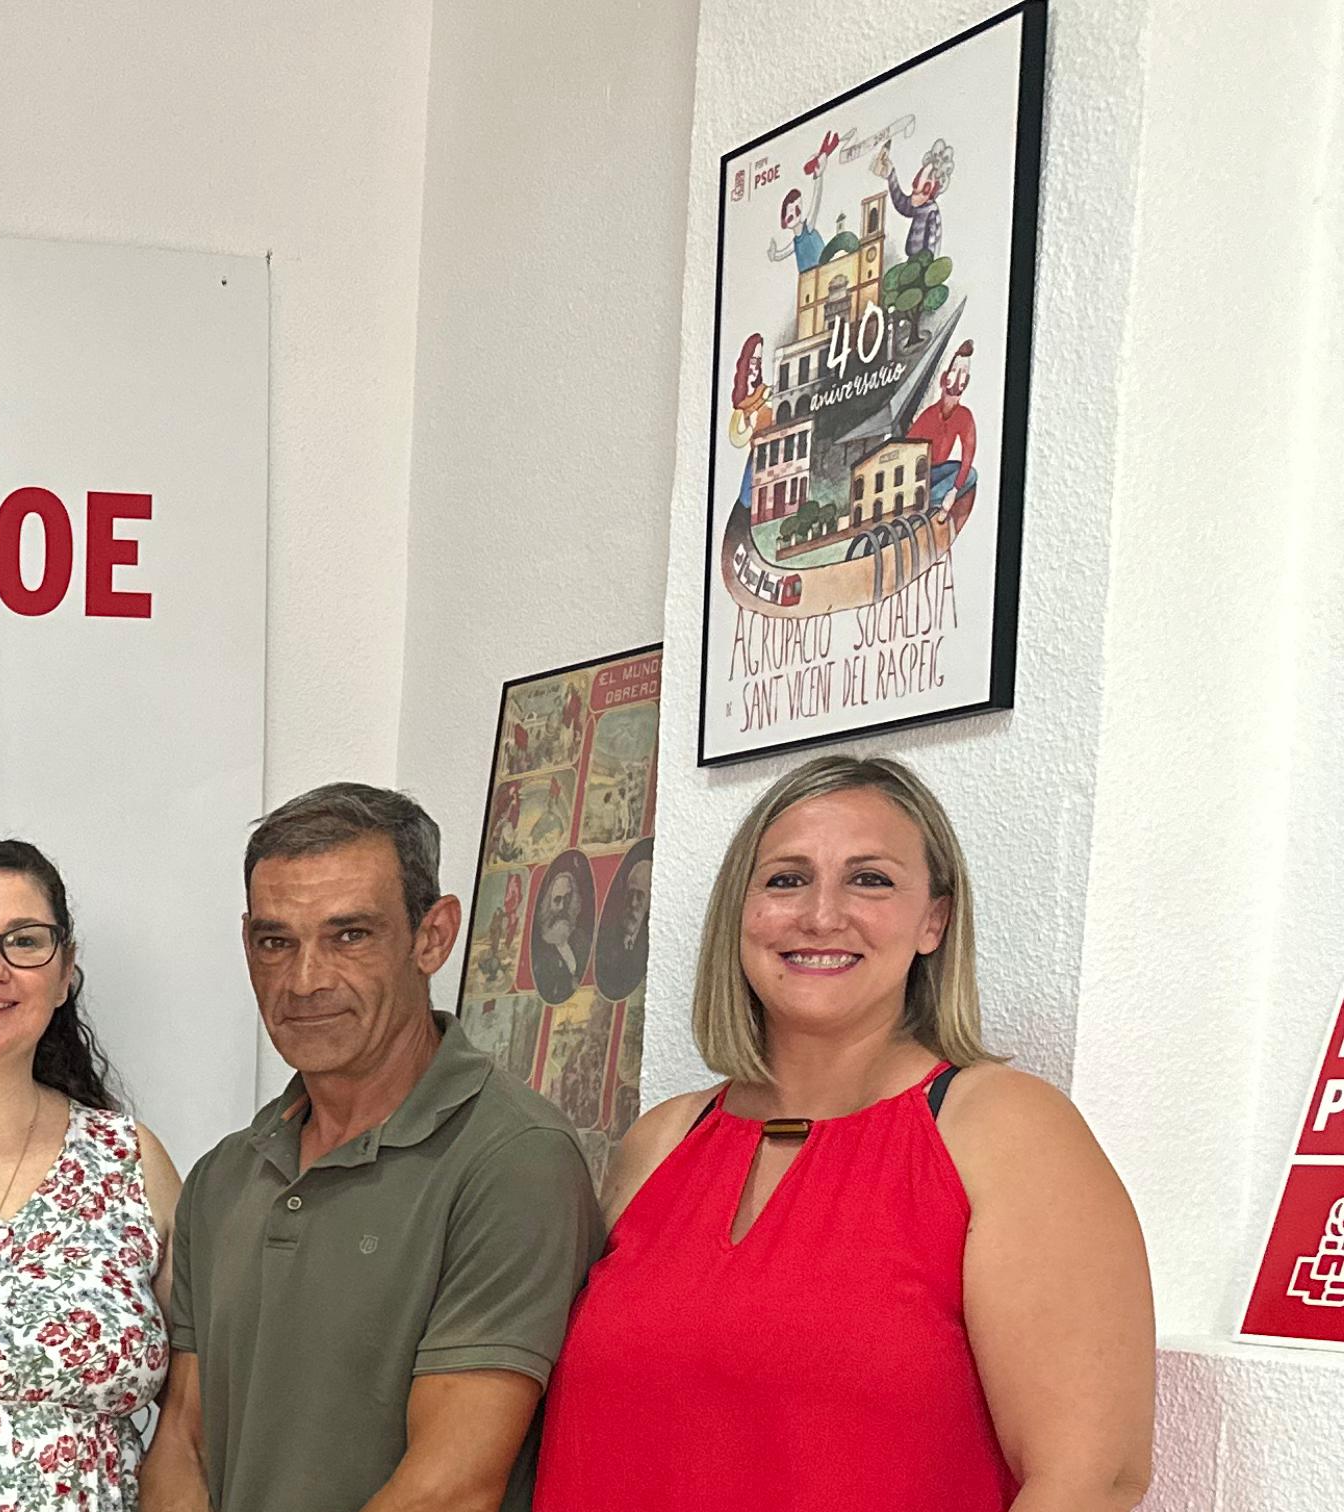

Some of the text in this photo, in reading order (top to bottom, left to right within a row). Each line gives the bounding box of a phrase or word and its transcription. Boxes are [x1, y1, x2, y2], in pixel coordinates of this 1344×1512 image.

[754, 164, 781, 190] PSOE
[826, 300, 885, 380] 40
[810, 363, 907, 411] aniversario
[728, 548, 958, 682] AGRUPACIÓ SOCIALISTA
[598, 671, 616, 687] EL
[740, 675, 784, 732] SANT
[787, 661, 835, 721] VICENT
[842, 656, 869, 708] DEL
[875, 636, 944, 701] RASPEIG
